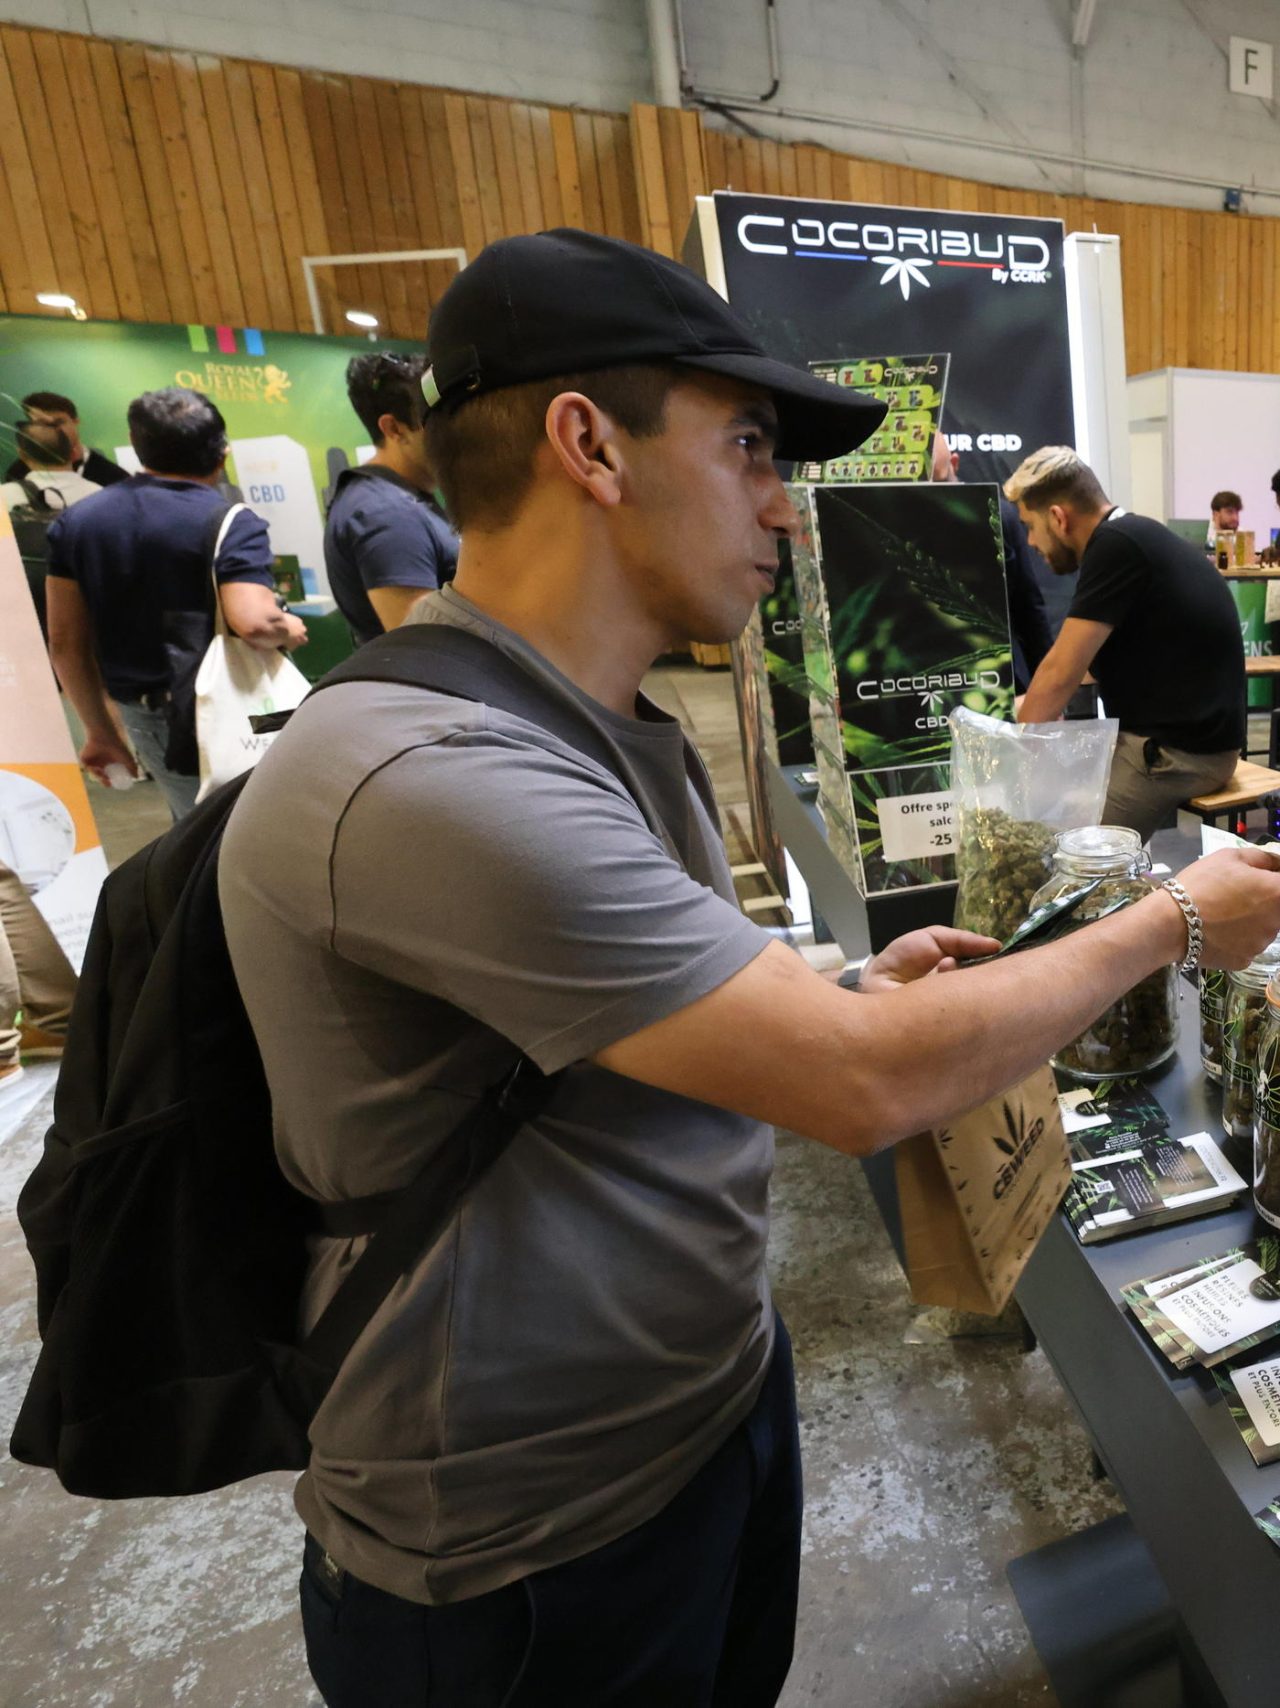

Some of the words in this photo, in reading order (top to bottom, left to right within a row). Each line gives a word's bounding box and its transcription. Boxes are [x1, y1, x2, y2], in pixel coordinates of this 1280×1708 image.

[1244, 48, 1259, 85] F
[737, 214, 1050, 271] COCORIBUD
[991, 268, 1009, 284] By
[976, 434, 1022, 452] CBD
[249, 484, 286, 503] CBD
[856, 670, 1000, 700] COCORIBUD
[901, 802, 933, 815] Offre
[1251, 1381, 1266, 1396] PLUS
